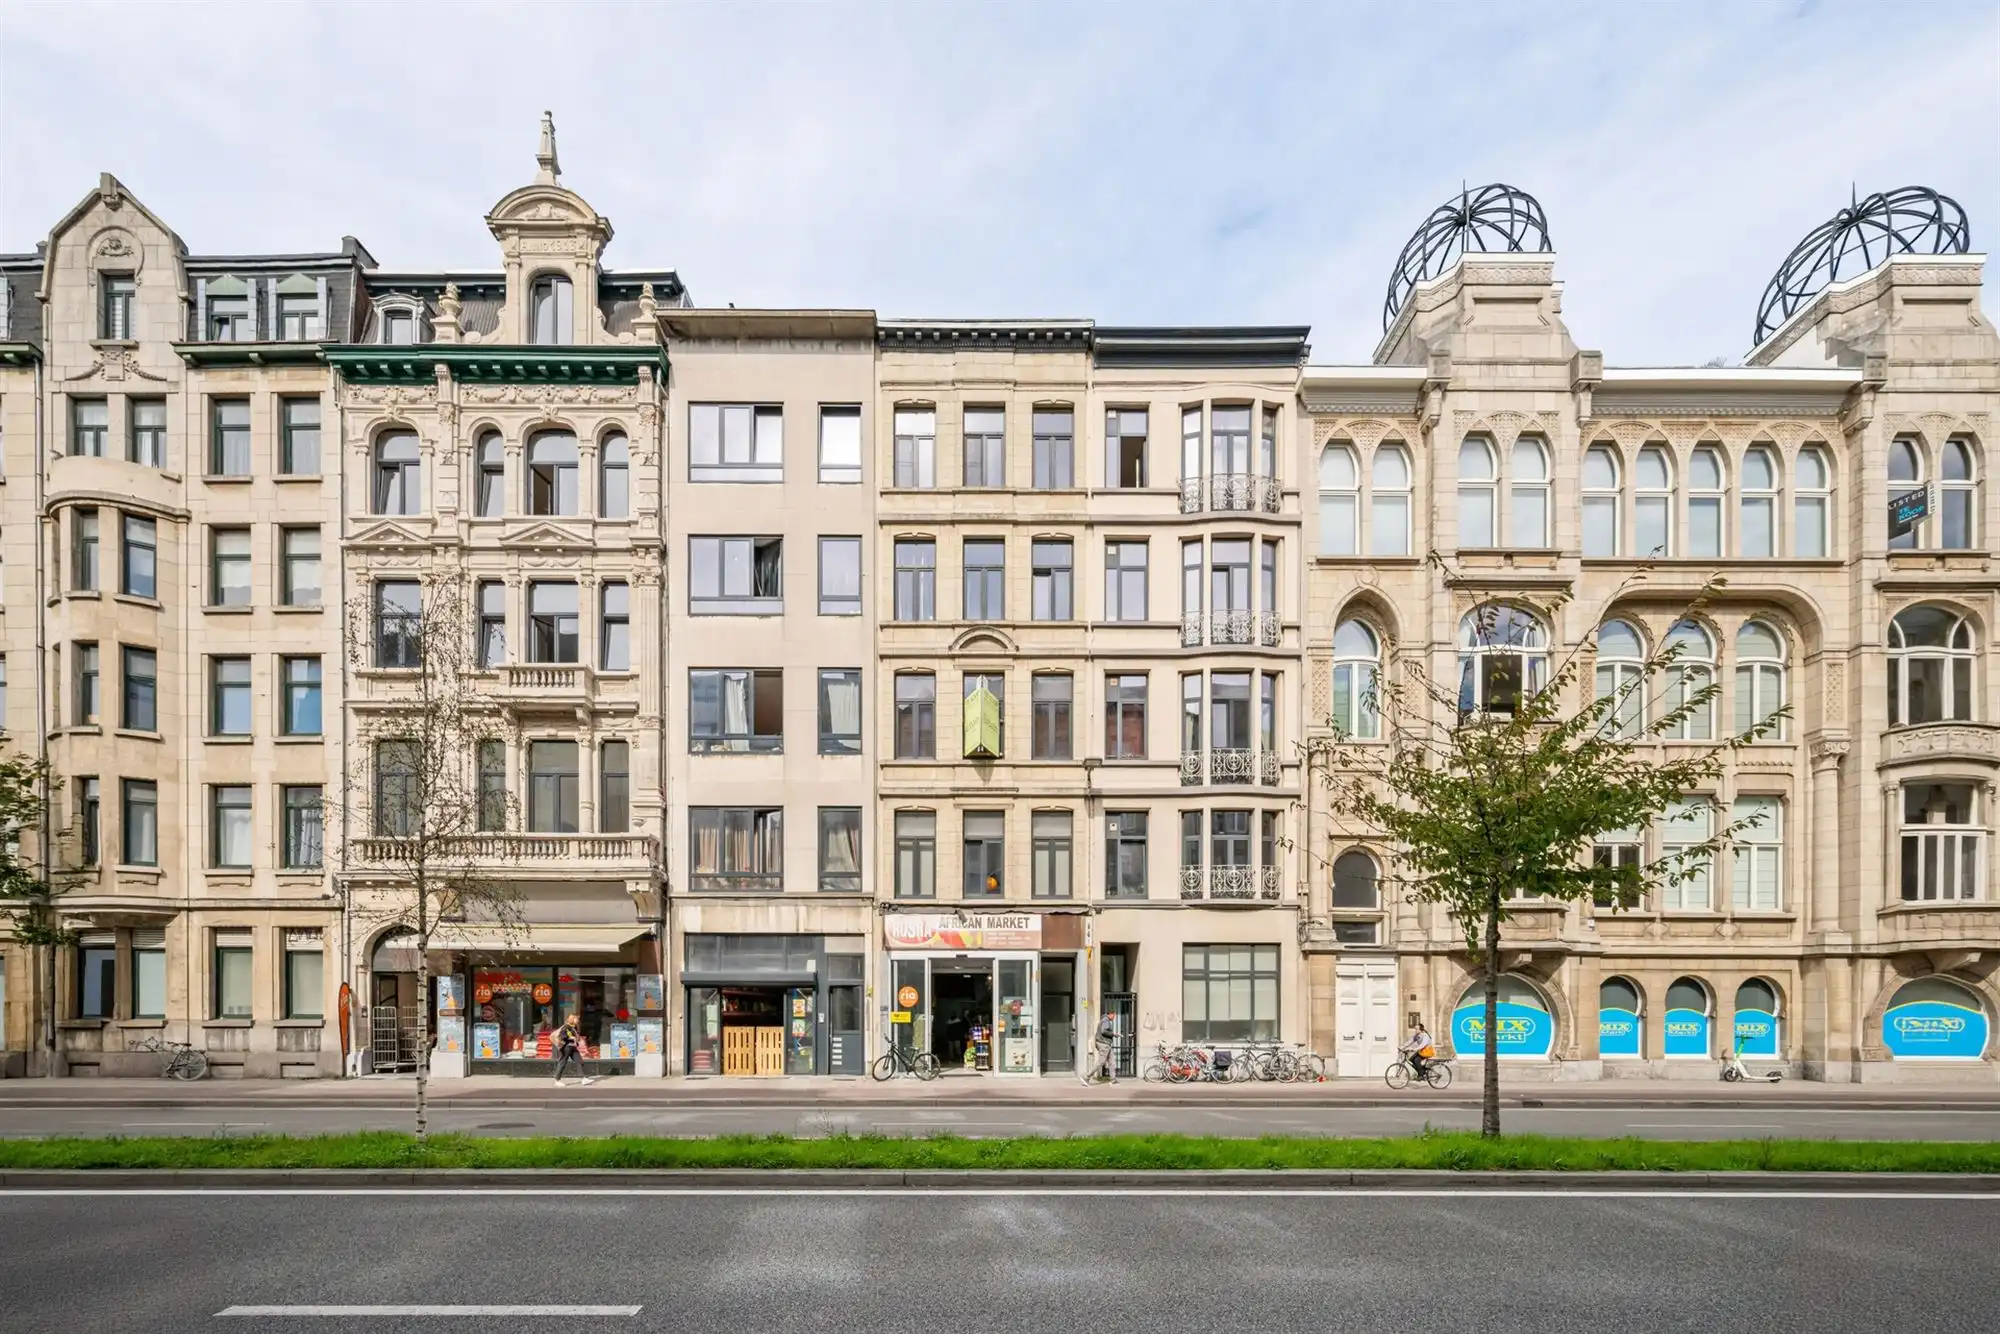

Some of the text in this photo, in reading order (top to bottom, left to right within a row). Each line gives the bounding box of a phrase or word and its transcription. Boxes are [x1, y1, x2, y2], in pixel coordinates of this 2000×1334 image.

[1888, 490, 1925, 510] LISTED
[938, 916, 1030, 929] AFRICAN MARKET
[475, 985, 491, 996] ria
[535, 985, 551, 996] ria
[900, 989, 916, 1000] ria
